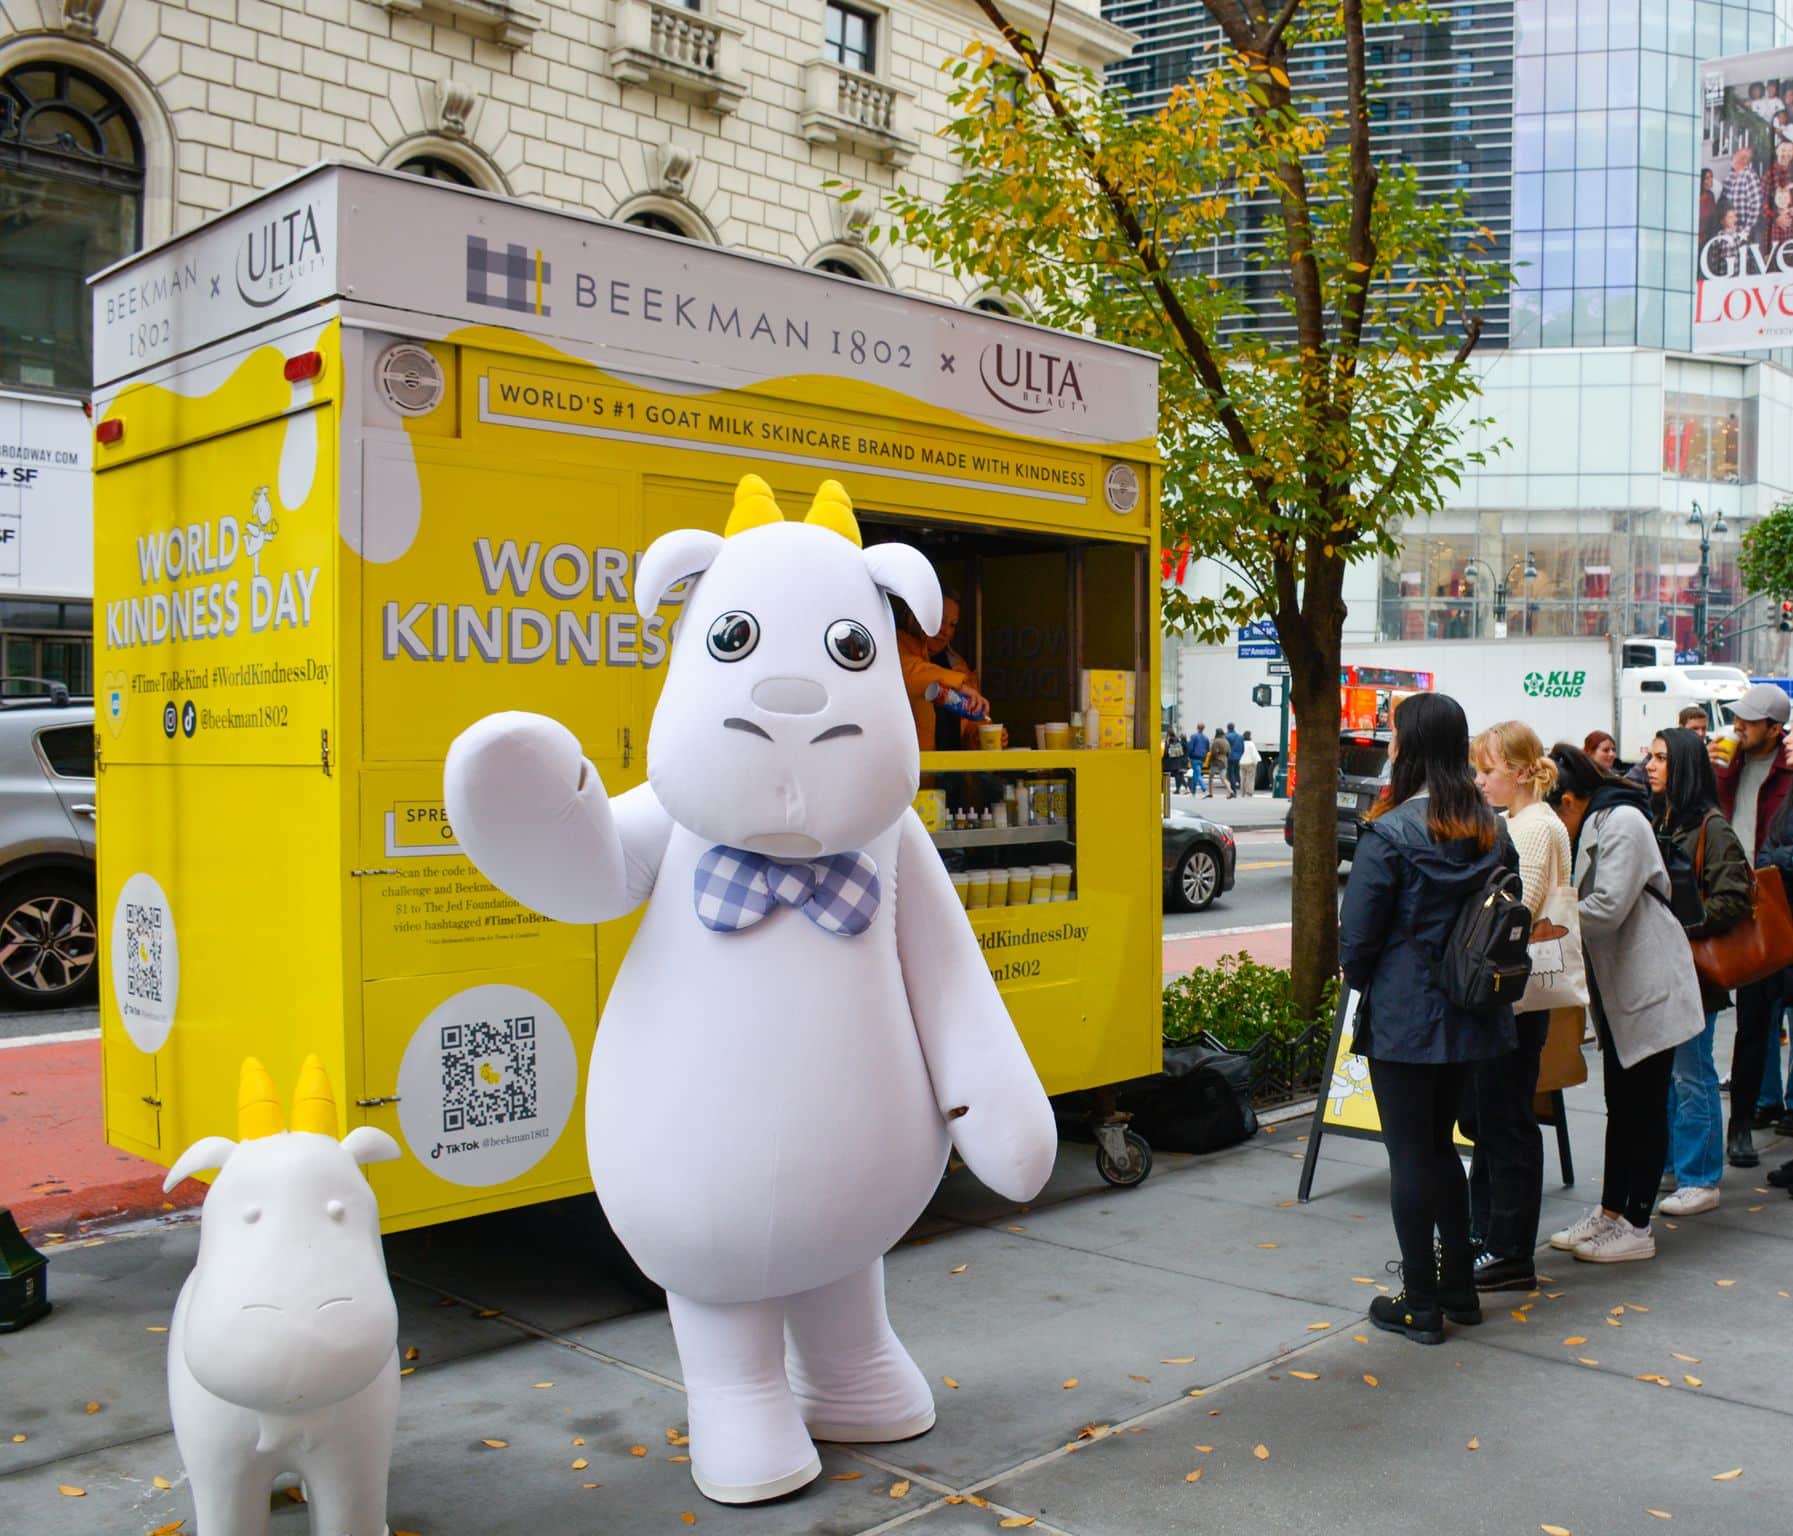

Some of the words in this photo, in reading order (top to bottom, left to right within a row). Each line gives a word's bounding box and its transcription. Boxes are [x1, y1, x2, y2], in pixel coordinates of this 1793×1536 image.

[107, 261, 198, 324] BEEKMAN
[248, 203, 321, 281] ULTA
[268, 256, 327, 290] BEAUTY
[129, 319, 170, 358] 1802
[576, 273, 809, 350] BEEKMAN
[832, 330, 911, 368] 1802
[996, 343, 1083, 401] ULTA
[1023, 391, 1089, 414] BEAUTY
[500, 383, 603, 416] WORLD'S
[613, 402, 635, 420] #1
[646, 406, 701, 429] GOAT
[709, 416, 754, 437] MILK
[762, 423, 850, 451] SKINCARE
[858, 438, 915, 461] BRAND
[921, 449, 967, 469] MADE
[972, 456, 1010, 475] WITH
[1016, 463, 1086, 487] KINDNESS
[13, 467, 38, 483] SF
[138, 516, 240, 585] WORLD
[106, 580, 241, 650] KINDNESS
[251, 567, 320, 632] DAY
[383, 601, 678, 669] KINDNES
[132, 668, 208, 694] #TimeToBeKind
[212, 658, 331, 687] #WorldKindnessDay
[1547, 671, 1586, 686] KLB
[1544, 687, 1582, 698] SONS
[201, 704, 288, 730] @beekman1802
[423, 865, 439, 877] the
[442, 864, 465, 876] code
[381, 885, 432, 897] challenge
[433, 882, 452, 894] and
[411, 903, 421, 913] to
[424, 901, 444, 913] The
[446, 900, 463, 913] Jed
[393, 920, 421, 932] video
[424, 915, 481, 931] hashtagged
[446, 1140, 480, 1154] TikTok
[483, 1127, 550, 1147] @beekman1802
